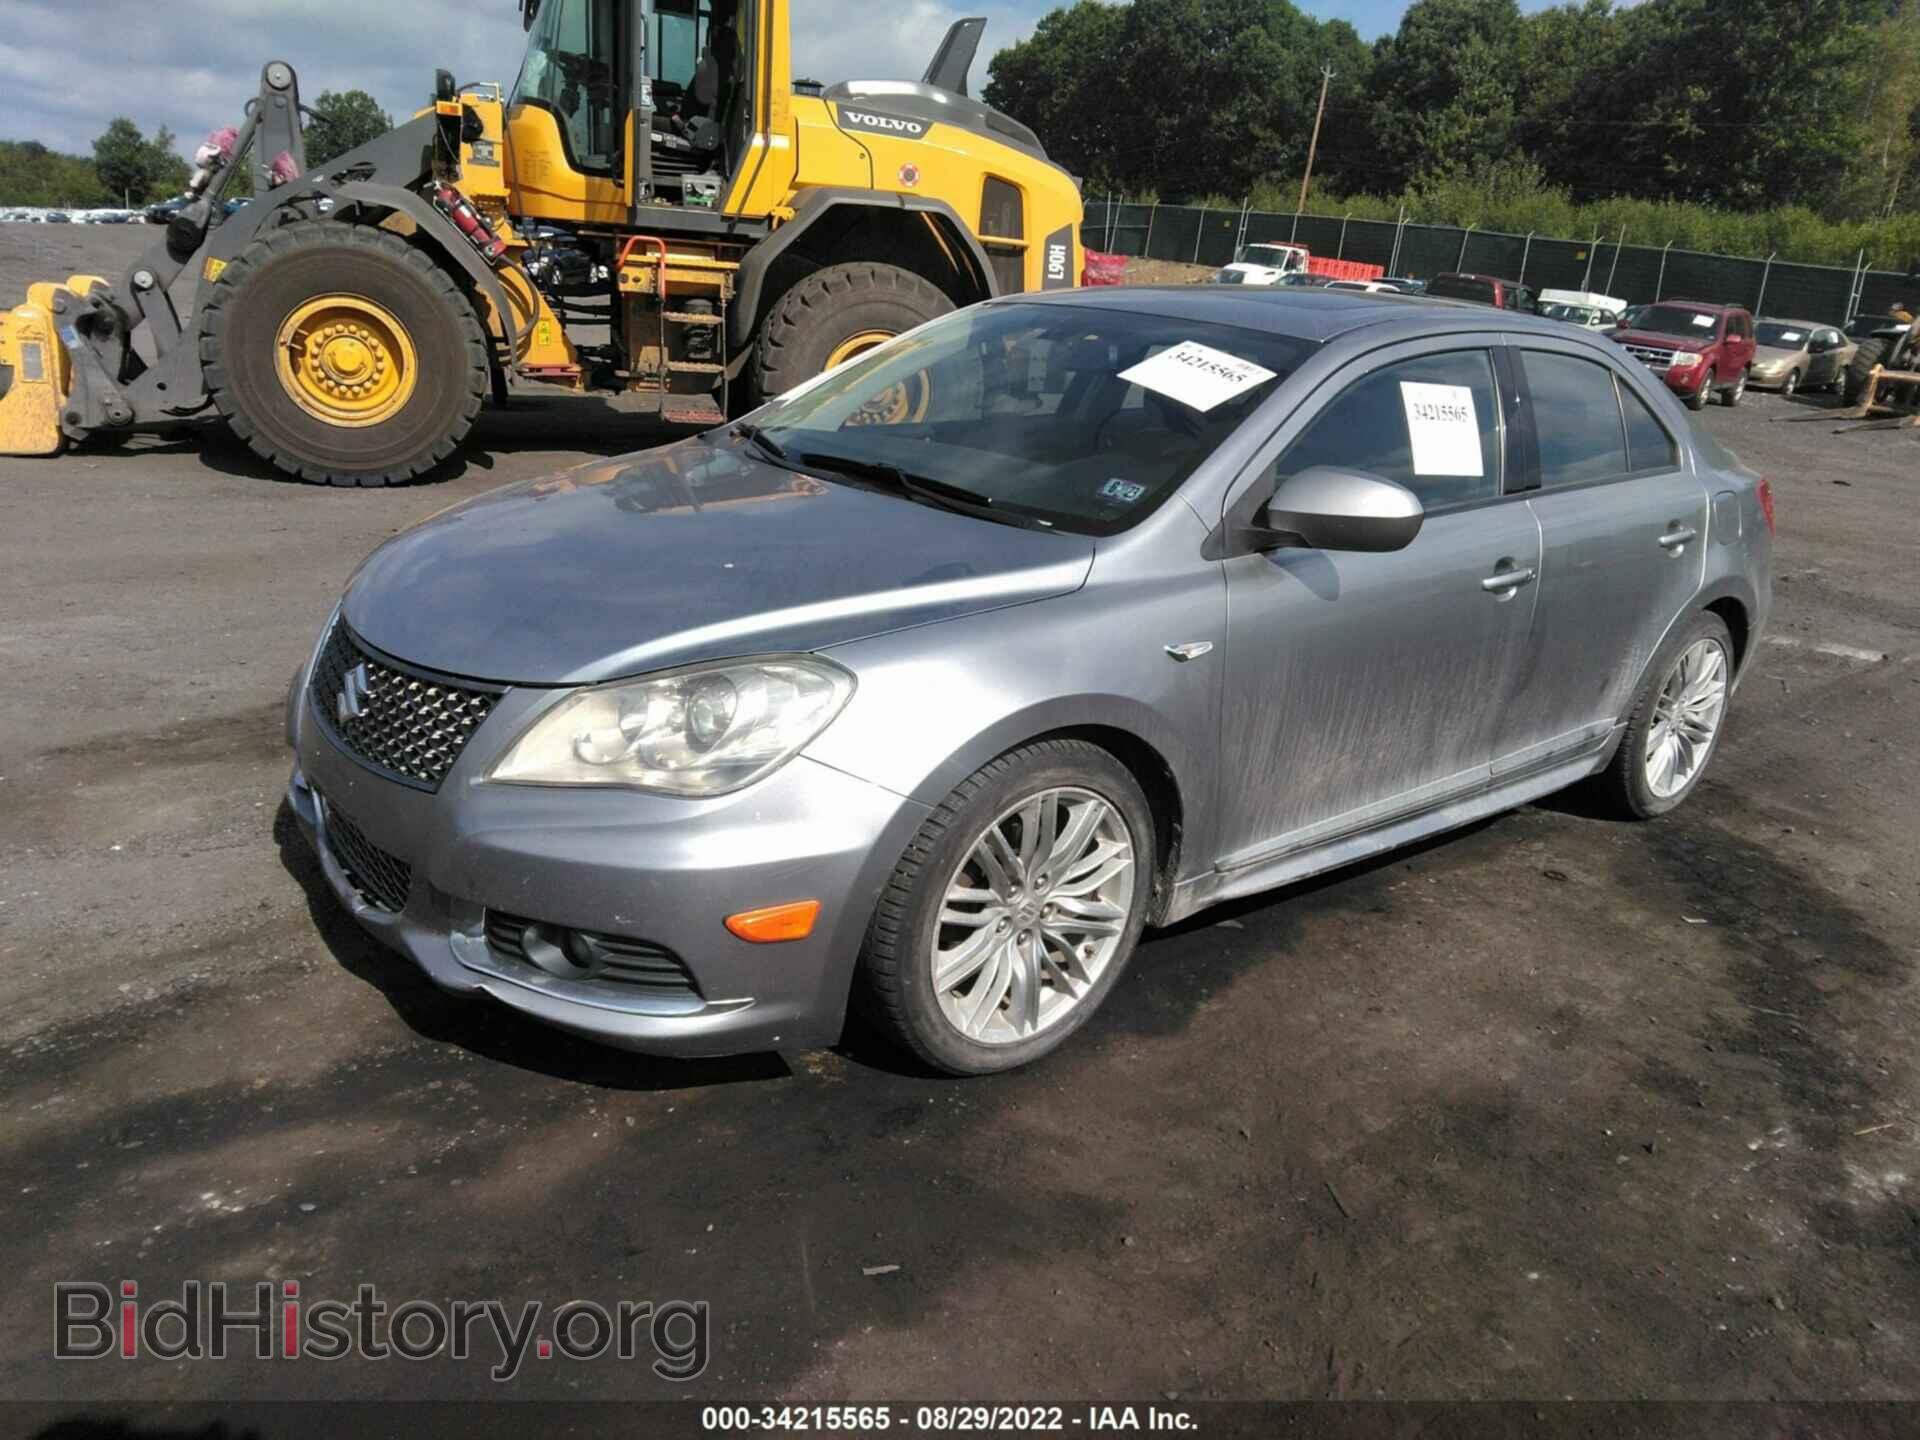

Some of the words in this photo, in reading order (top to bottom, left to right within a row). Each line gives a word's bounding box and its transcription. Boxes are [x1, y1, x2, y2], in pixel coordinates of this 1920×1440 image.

[844, 111, 922, 133] VOLVO
[1047, 244, 1067, 280] L90H
[1168, 351, 1247, 383] 34215565
[1413, 402, 1469, 423] 34215565
